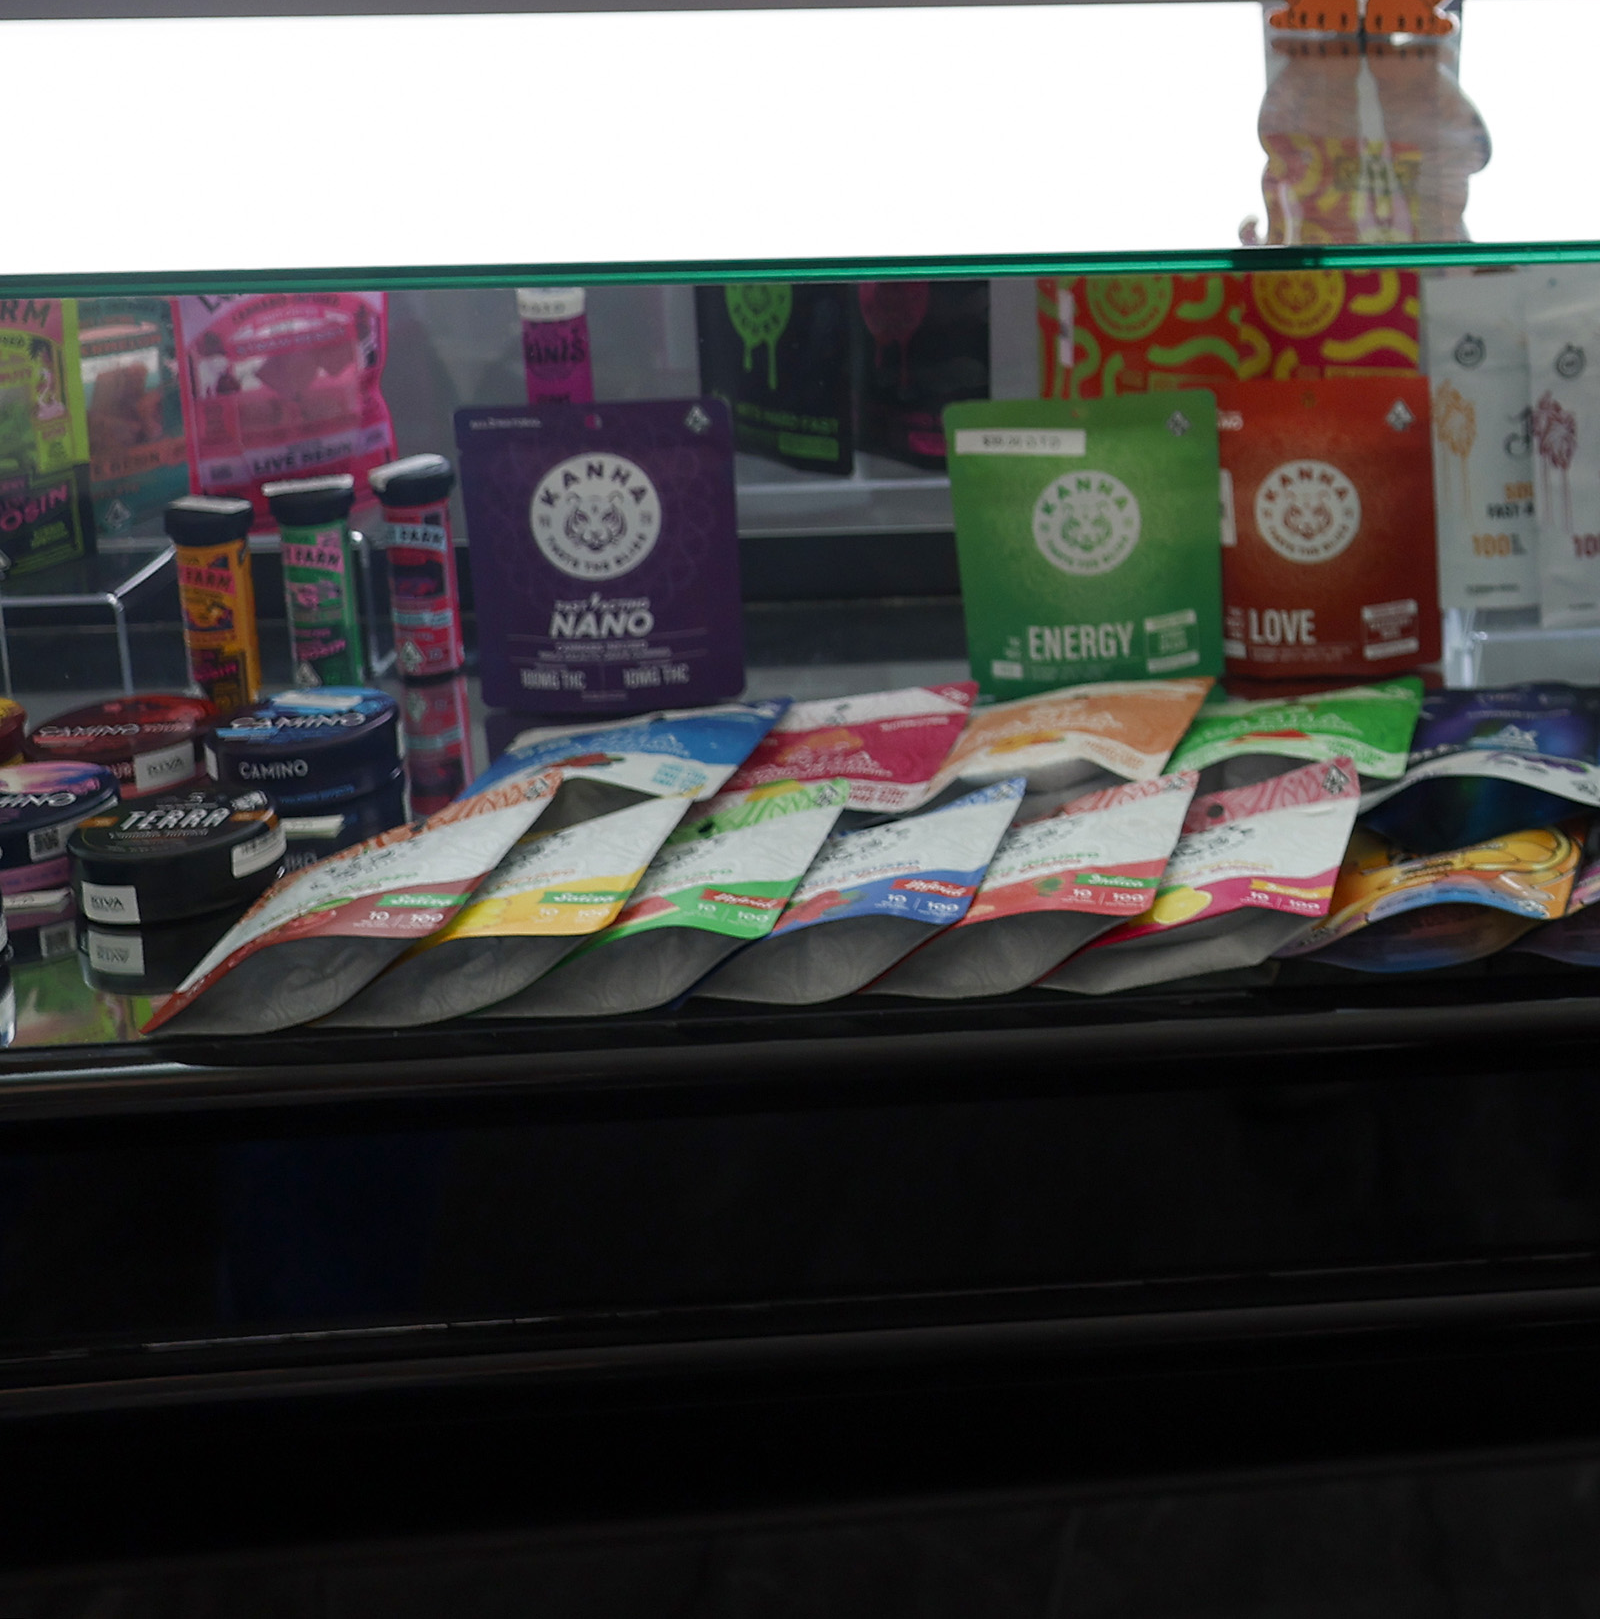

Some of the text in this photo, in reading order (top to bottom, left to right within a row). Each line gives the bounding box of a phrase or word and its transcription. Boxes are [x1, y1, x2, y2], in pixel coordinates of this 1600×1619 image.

[540, 462, 648, 507] KANHA
[1040, 476, 1129, 516] KANHA
[1264, 467, 1349, 503] KANHA
[550, 608, 655, 639] NANO
[1027, 620, 1135, 661] ENERGY
[1250, 608, 1317, 645] LOVE
[239, 758, 309, 781] CAMINO
[119, 807, 231, 831] TERRA
[90, 895, 124, 910] KIVA
